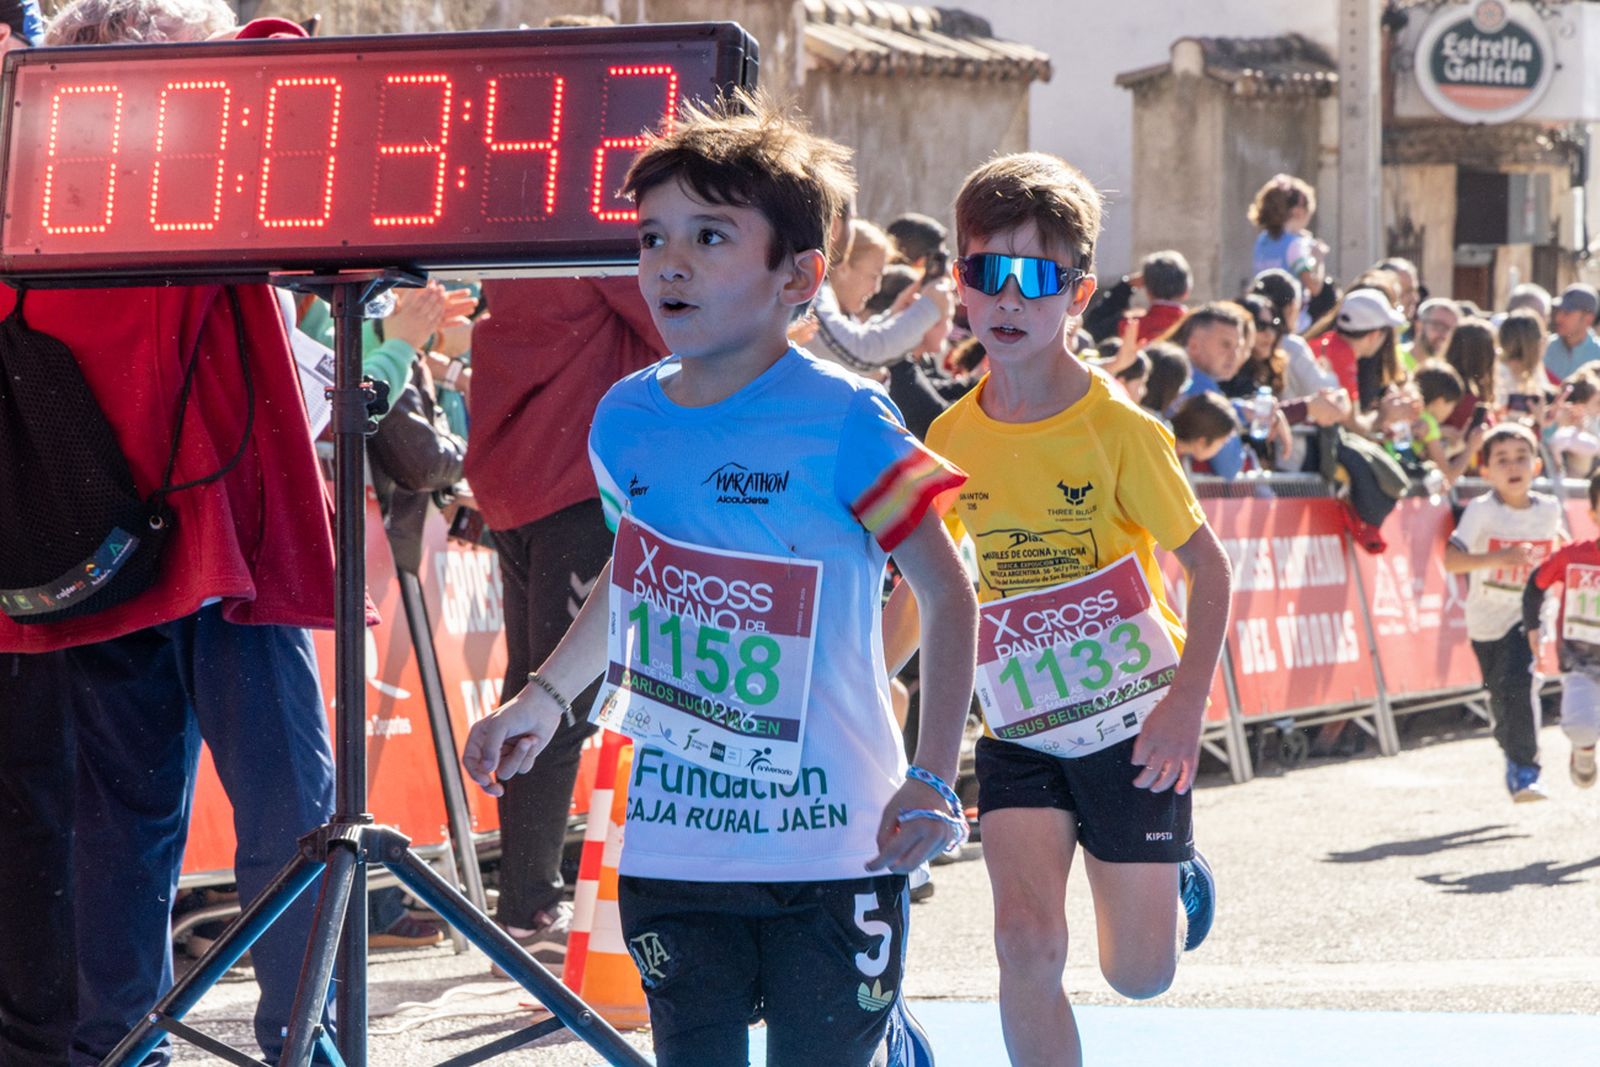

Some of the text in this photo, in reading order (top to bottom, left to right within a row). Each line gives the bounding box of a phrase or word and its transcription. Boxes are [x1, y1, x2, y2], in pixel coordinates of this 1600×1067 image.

[1441, 31, 1533, 63] Estrella
[1443, 57, 1528, 85] Galicia
[716, 470, 790, 496] MARATHON
[716, 495, 770, 505] Alcaudete
[1047, 508, 1074, 516] THREE
[1011, 549, 1021, 559] DE
[1023, 547, 1051, 558] COCINA
[635, 536, 660, 585] X
[661, 564, 774, 613] CROSS
[633, 578, 741, 636] PANTANO
[745, 619, 770, 634] DEL
[984, 608, 1021, 644] X
[1022, 589, 1119, 635] CROSS
[628, 601, 782, 705] 1158
[994, 614, 1127, 665] PANTANO DEL
[998, 622, 1152, 711] 1133
[621, 670, 674, 702] CARLOS
[1000, 719, 1046, 739] JESUS
[757, 764, 794, 777] Aniversario
[685, 806, 769, 834] RURAL
[777, 798, 848, 832] JAÉN
[854, 891, 893, 977] 5
